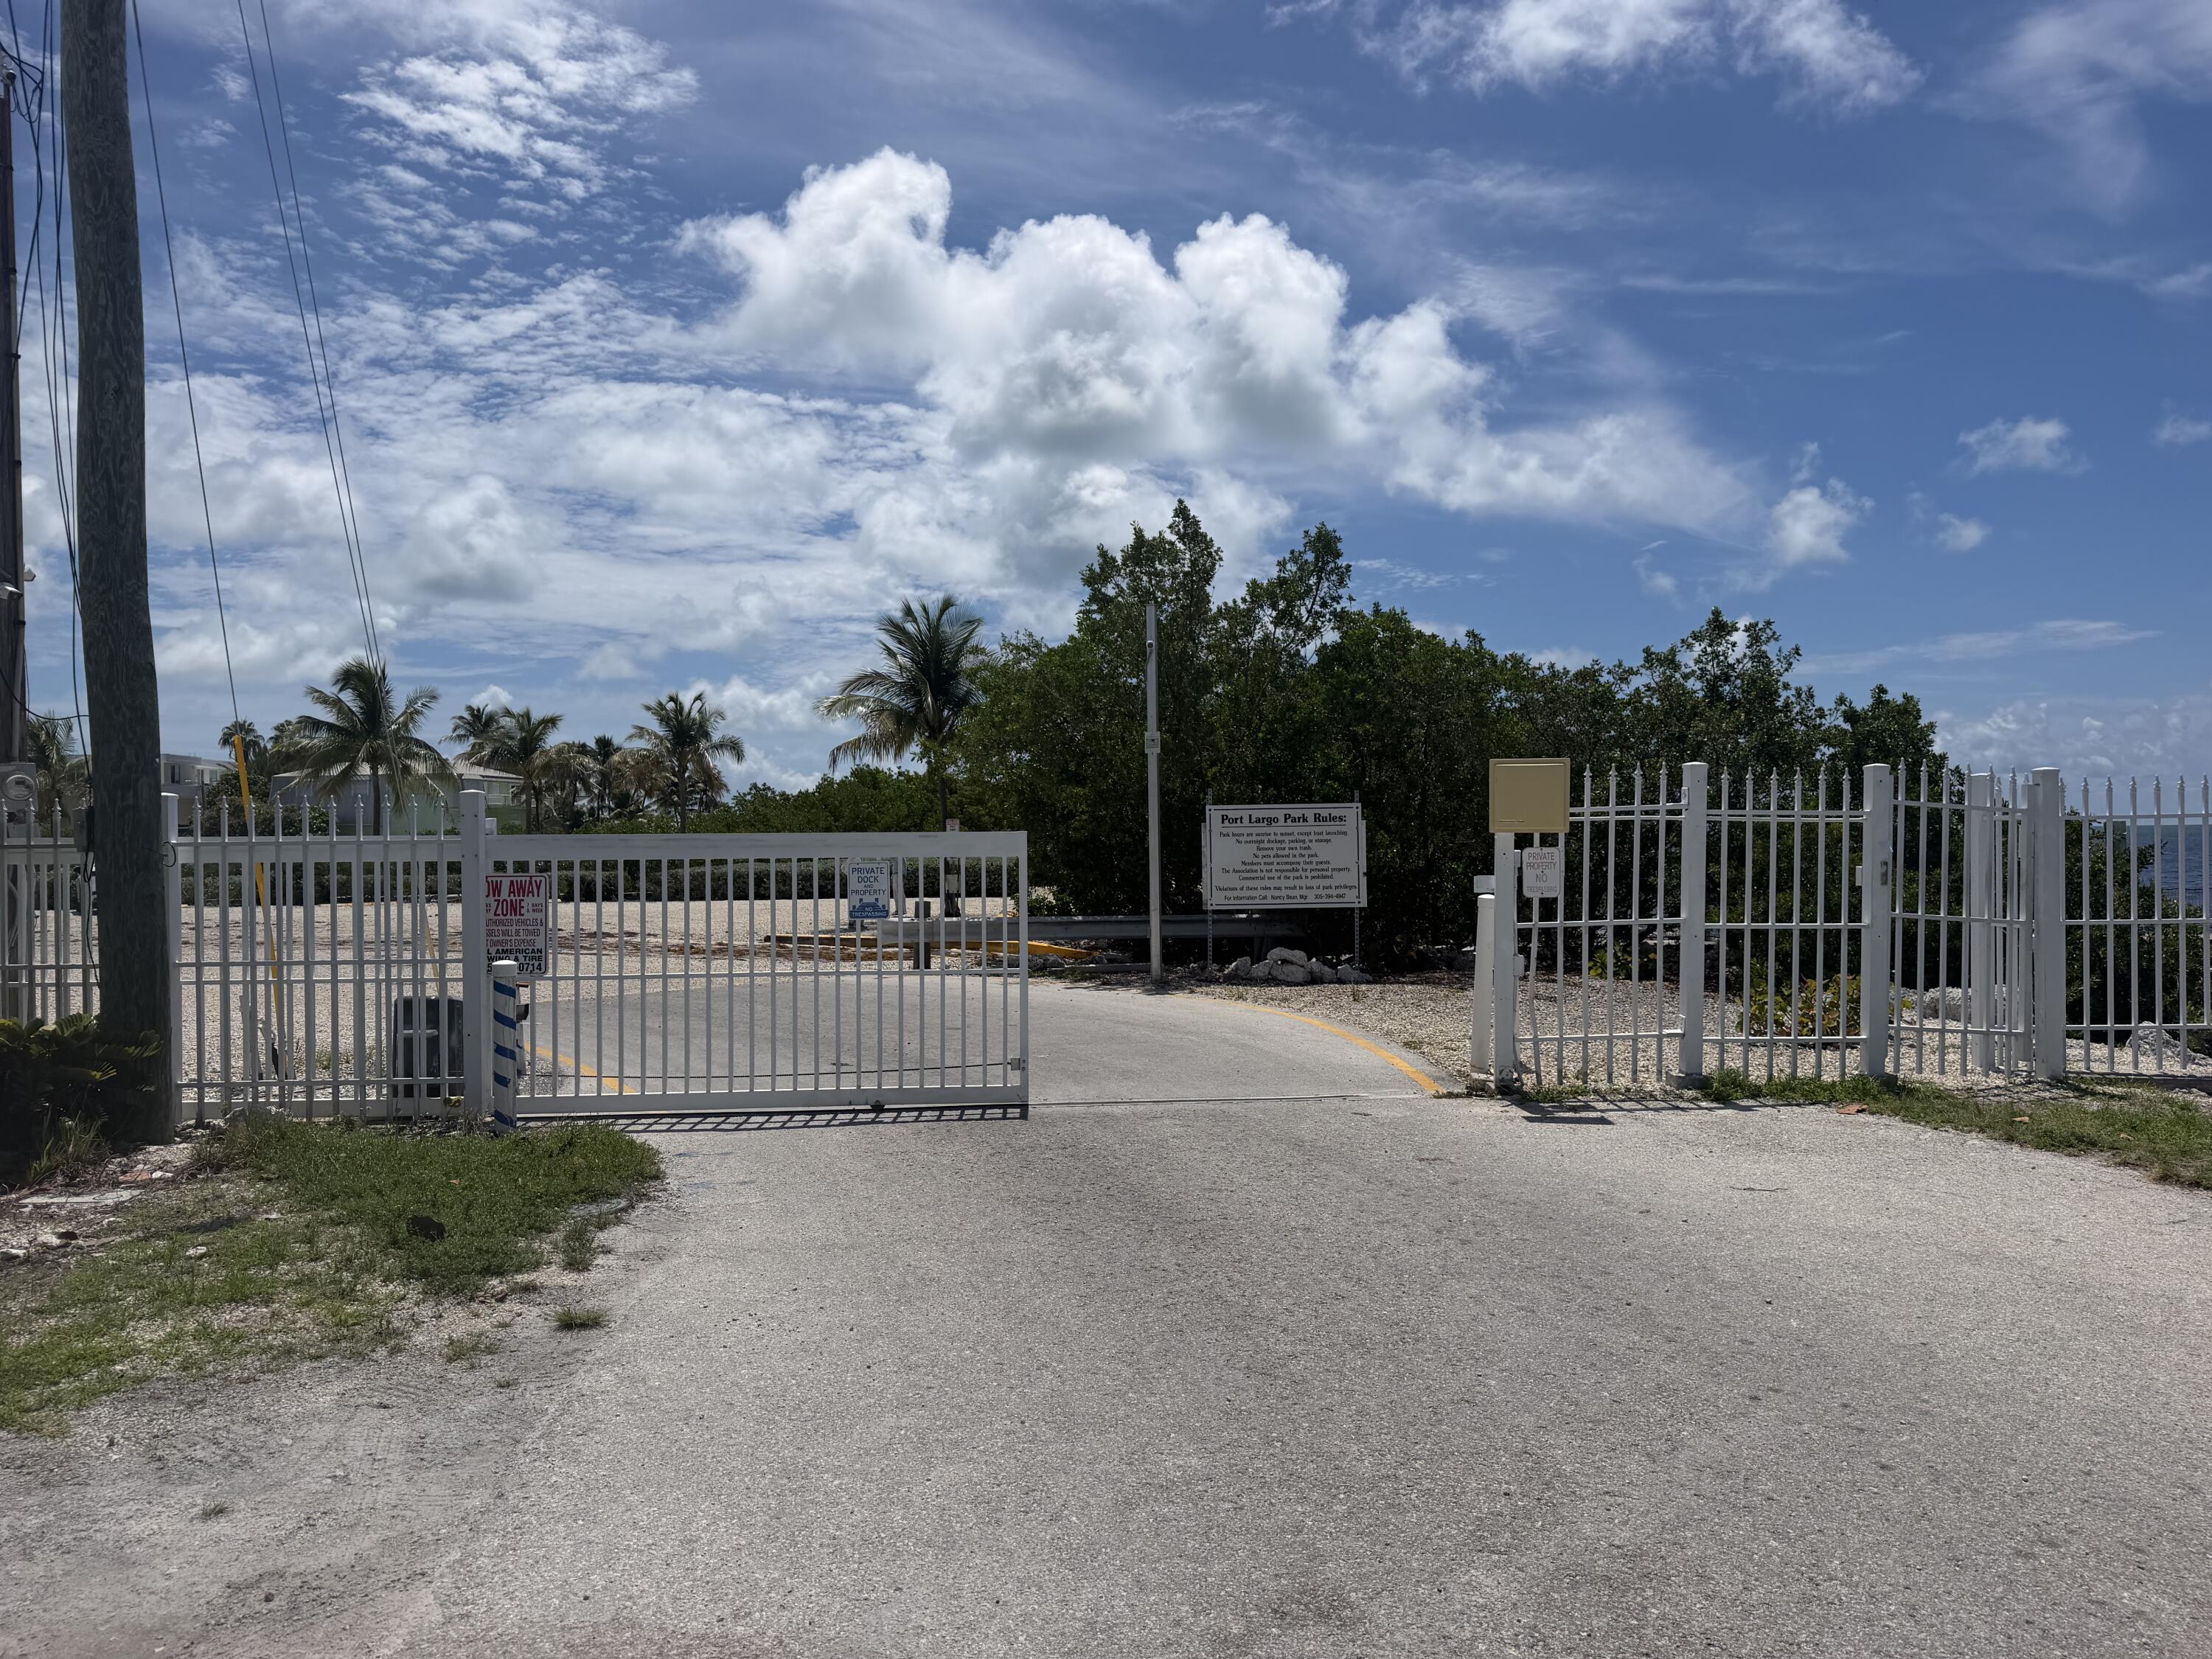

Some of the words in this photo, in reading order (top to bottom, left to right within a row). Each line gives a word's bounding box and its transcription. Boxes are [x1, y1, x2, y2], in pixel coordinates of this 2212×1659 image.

[1220, 814, 1244, 824] Port
[1248, 813, 1279, 826] Largo
[1284, 813, 1309, 824] Park
[1313, 813, 1346, 823] Rules:
[1528, 852, 1555, 860] PRIVATE
[1526, 861, 1557, 870] PROPERTY
[858, 875, 879, 883] DOCK
[1536, 874, 1548, 883] NO
[486, 879, 502, 898] OW
[508, 879, 542, 897] AWAY
[493, 898, 524, 917] ZONE
[486, 917, 515, 928] UTHORIZED
[515, 918, 538, 927] VEHICLES
[539, 918, 543, 926] &
[486, 928, 501, 937] SSELS
[501, 928, 514, 937] WILL
[515, 928, 521, 937] BE
[522, 928, 540, 936] TOWED
[514, 939, 536, 947] EXPENSE
